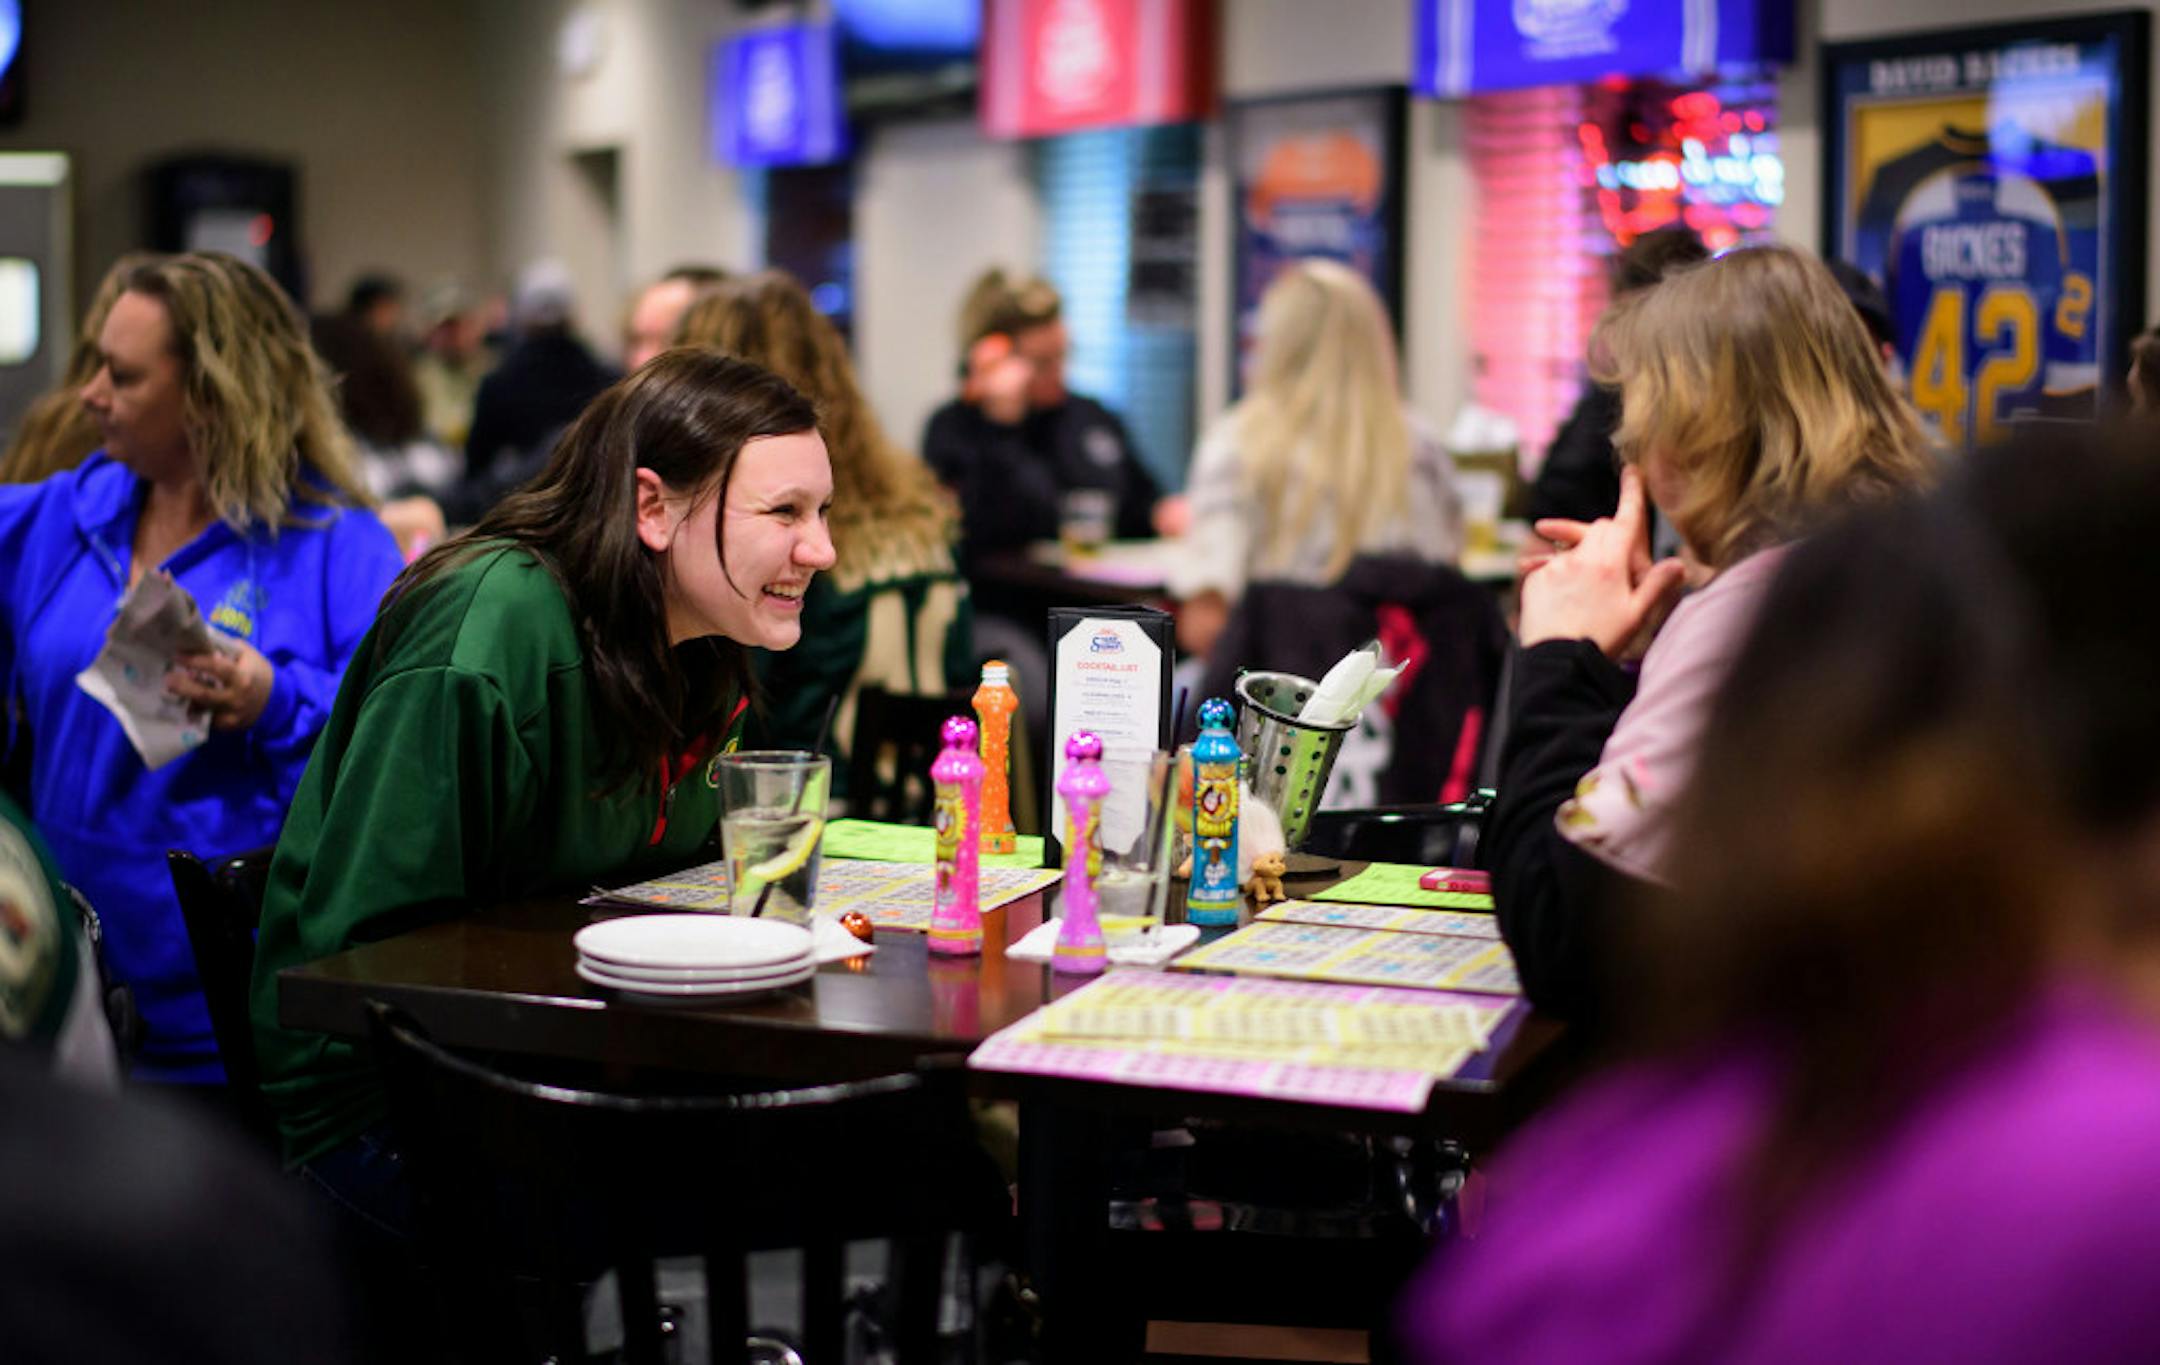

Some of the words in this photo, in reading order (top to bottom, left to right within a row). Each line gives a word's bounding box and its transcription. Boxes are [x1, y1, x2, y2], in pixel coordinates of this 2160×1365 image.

[1910, 287, 2039, 447] 42
[1077, 661, 1119, 672] COCKTAIL
[1120, 664, 1138, 673] LIST
